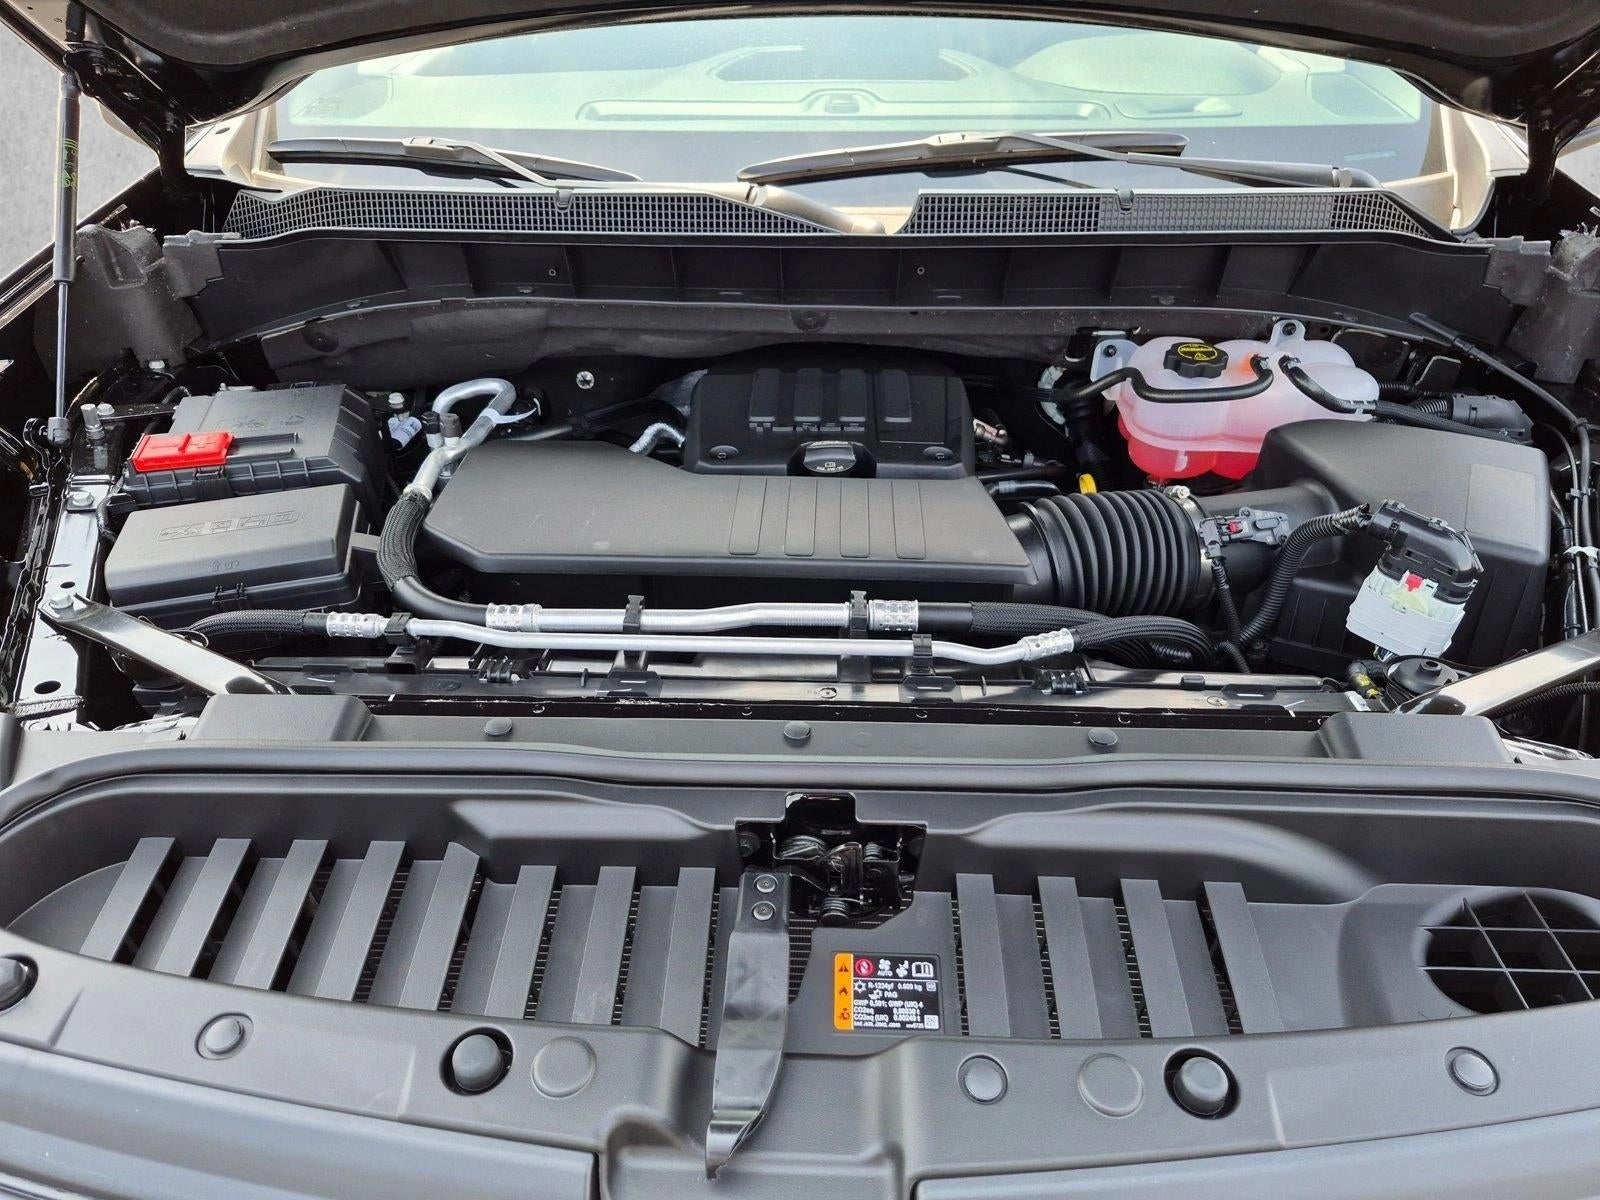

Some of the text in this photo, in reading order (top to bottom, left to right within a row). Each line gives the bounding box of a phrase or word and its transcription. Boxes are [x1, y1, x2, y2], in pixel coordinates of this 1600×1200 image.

[868, 982, 894, 990] R-1234yf
[914, 983, 923, 992] kg
[854, 999, 869, 1007] GWP
[888, 1000, 904, 1008] GWP
[904, 1000, 918, 1009] (UK)
[854, 1007, 875, 1015] CO2eq
[854, 1014, 875, 1022] CO2eq
[874, 1014, 889, 1023] (UK)
